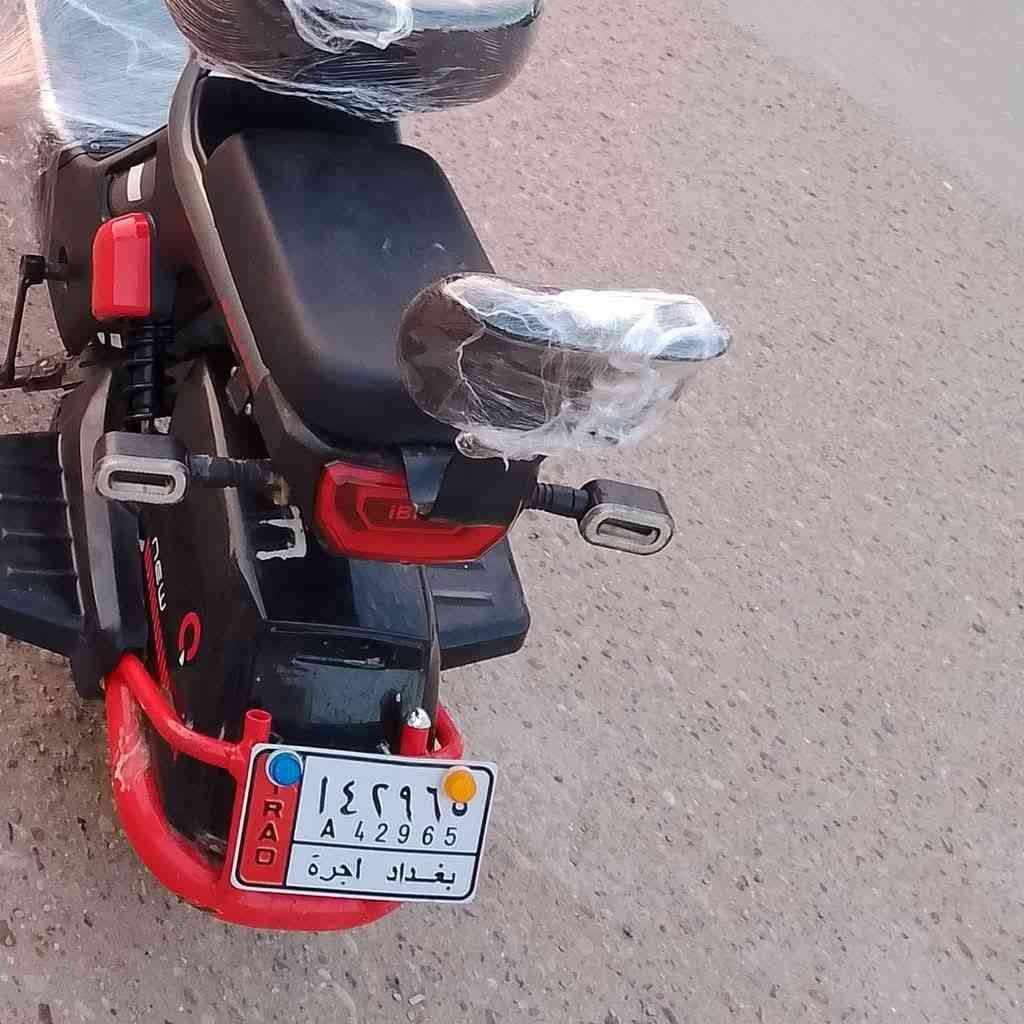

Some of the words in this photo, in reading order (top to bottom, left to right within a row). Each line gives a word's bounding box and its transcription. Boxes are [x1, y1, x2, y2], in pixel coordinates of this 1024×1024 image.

[320, 818, 336, 839] A
[354, 821, 457, 847] 42965
[386, 862, 456, 891] بغداد
